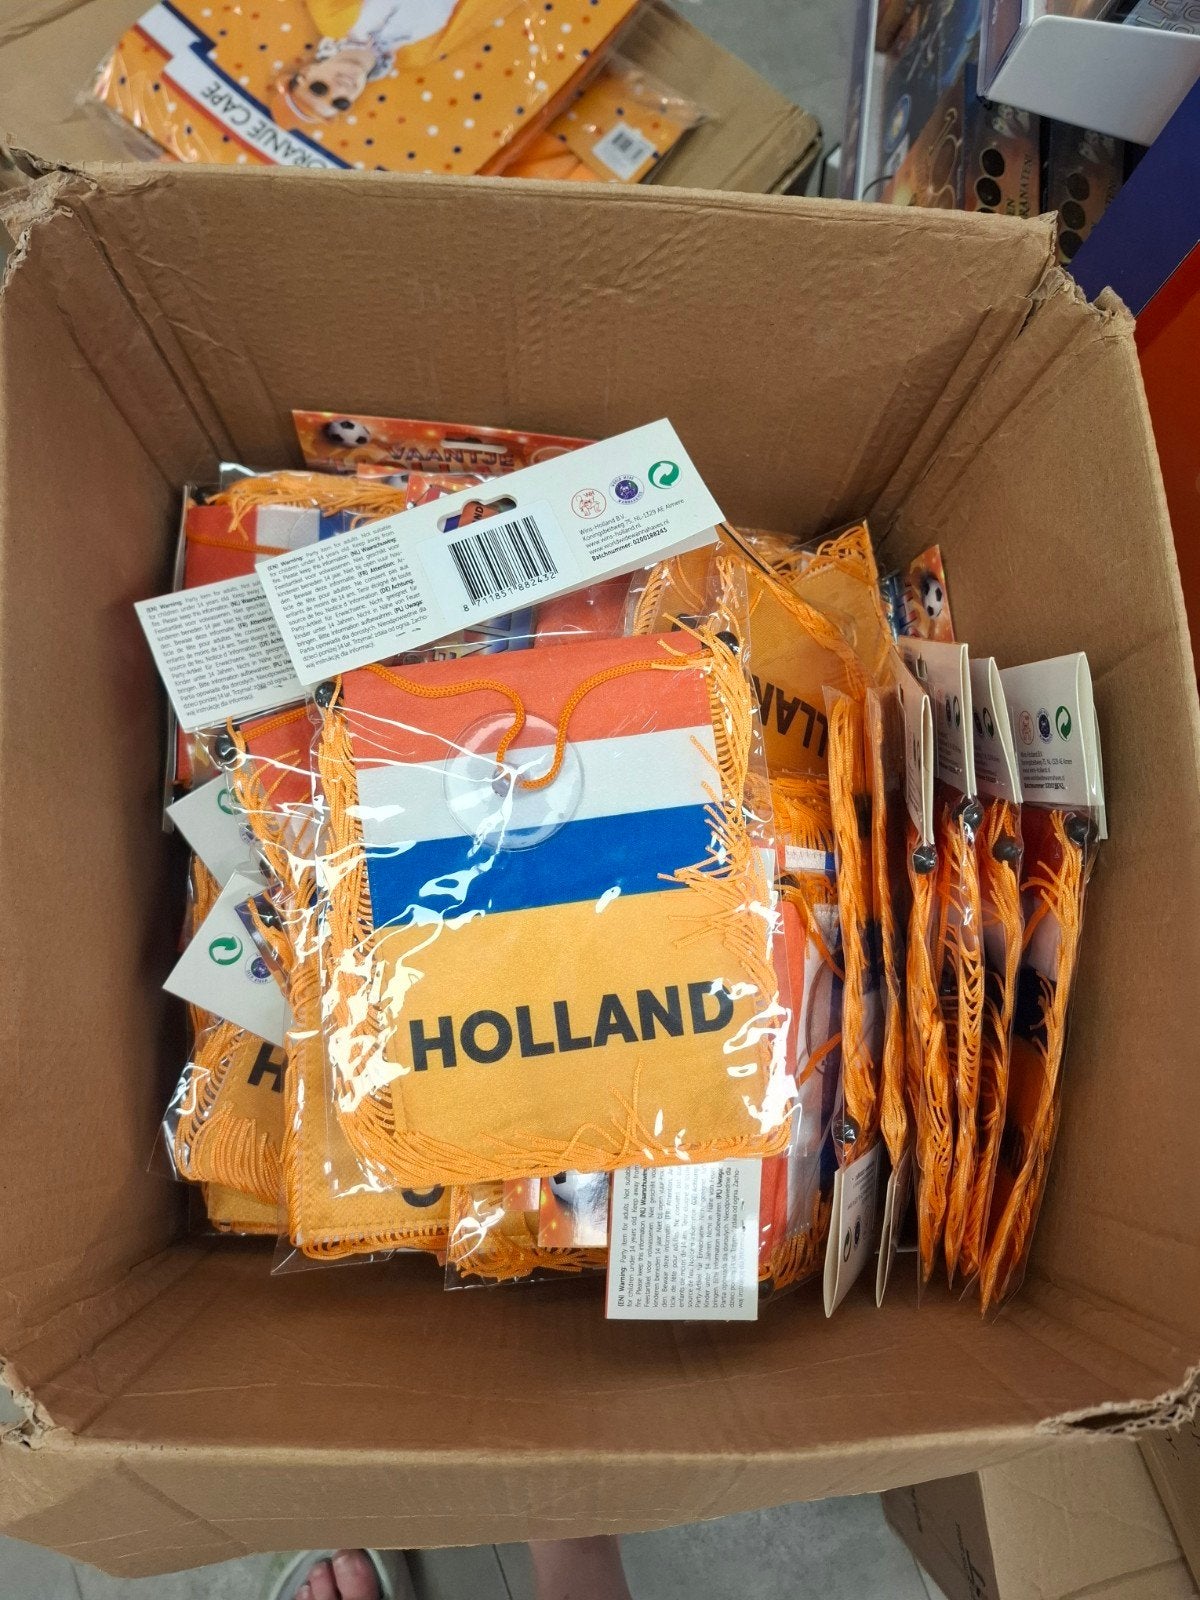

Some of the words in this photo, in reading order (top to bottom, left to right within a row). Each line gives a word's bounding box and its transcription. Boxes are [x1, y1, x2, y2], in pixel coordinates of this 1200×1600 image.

[201, 81, 251, 126] CAPE
[389, 447, 515, 467] VAANTJE
[462, 603, 470, 612] 8
[475, 587, 514, 607] 711851
[516, 571, 556, 592] 882432
[409, 981, 735, 1072] HOLLAND
